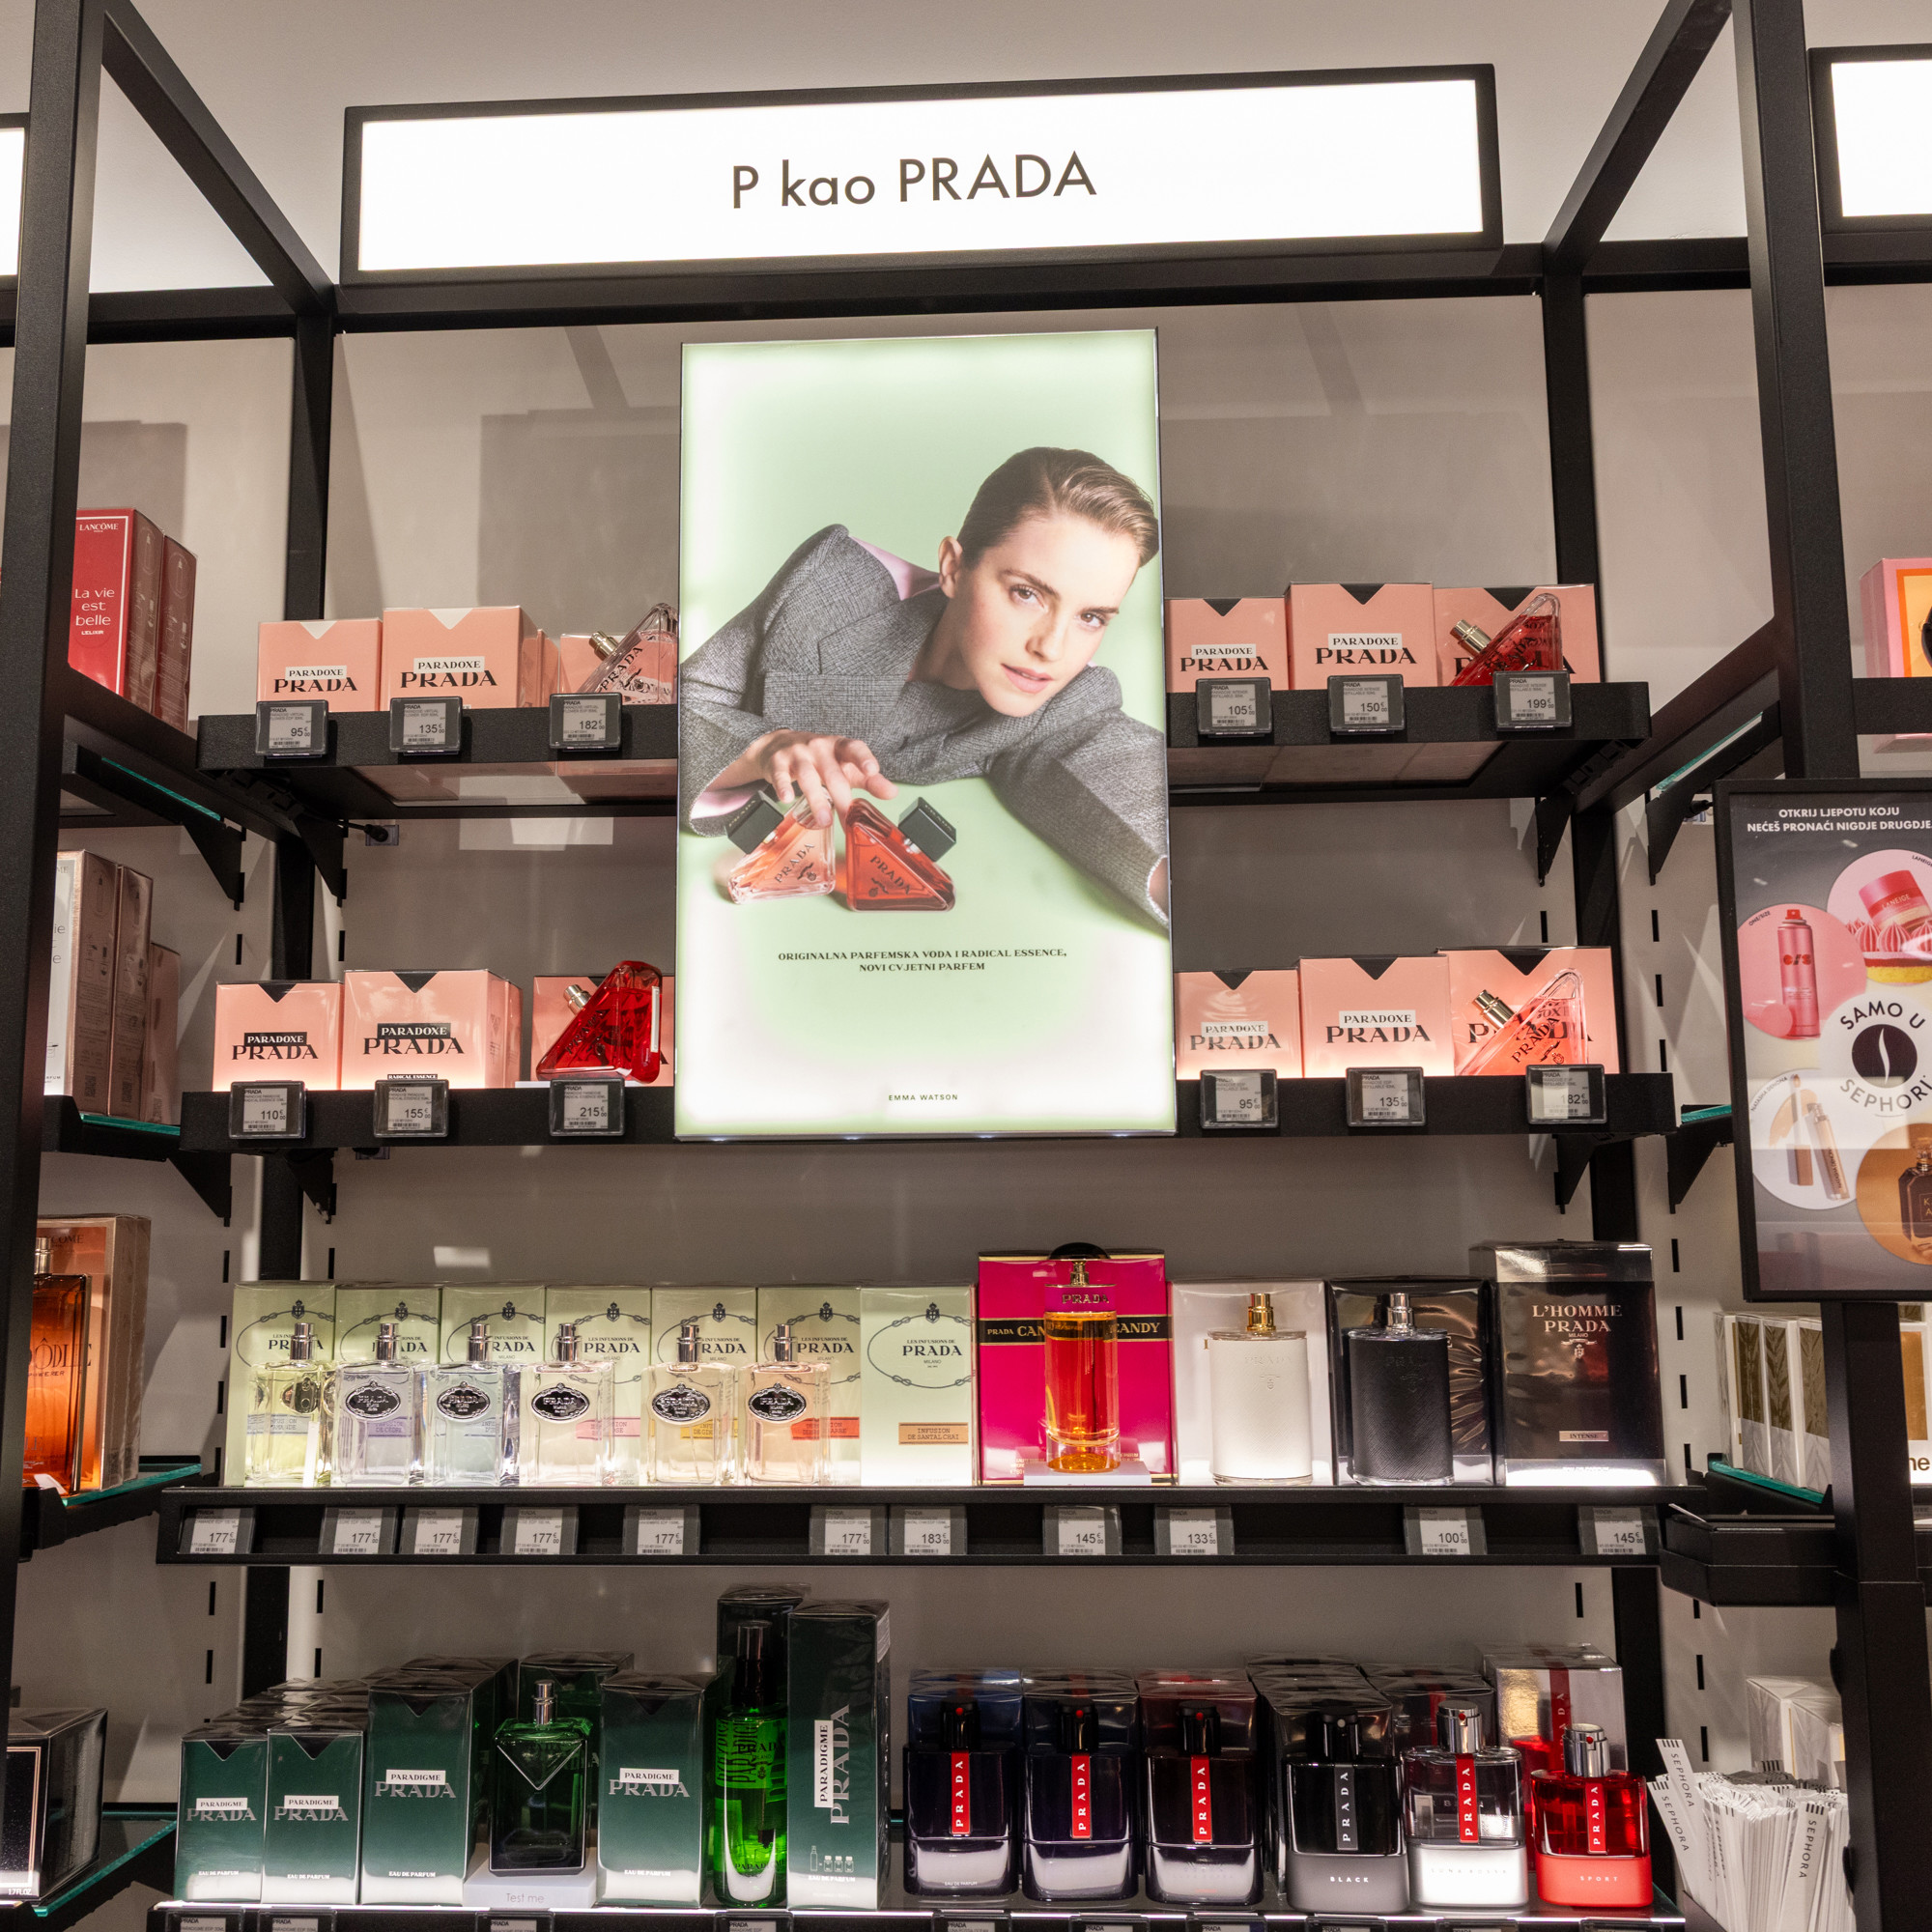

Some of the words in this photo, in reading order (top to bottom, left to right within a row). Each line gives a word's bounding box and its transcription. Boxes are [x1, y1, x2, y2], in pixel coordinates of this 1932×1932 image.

[733, 165, 759, 209] P
[781, 158, 875, 206] kao
[899, 150, 1097, 203] PRADA
[79, 523, 119, 531] LANCÔME
[74, 588, 90, 599] La
[95, 587, 115, 598] vie
[81, 602, 106, 611] est
[75, 614, 111, 626] belle
[1333, 637, 1398, 646] PARADOXE
[1195, 647, 1253, 656] PARADOXE
[1315, 646, 1417, 665] PRADA
[417, 660, 481, 670] PARADOXE
[600, 646, 644, 692] PRADA
[1180, 656, 1269, 672] PRADA
[289, 668, 344, 677] PARADOXE
[400, 669, 497, 689] PRADA
[273, 677, 357, 694] PRADA
[1361, 702, 1380, 712] 150
[1527, 698, 1547, 708] 199
[1229, 705, 1248, 715] 105
[419, 724, 438, 733] 135
[580, 720, 598, 729] 182
[291, 727, 303, 736] 95
[1778, 809, 1817, 818] OTKRIJ
[1820, 808, 1866, 817] LJEPOTU
[1869, 807, 1900, 816] KOJU
[1747, 821, 1780, 832] NEĆEŠ
[1783, 820, 1834, 832] PRONAĆI
[1836, 821, 1878, 831] NIGDJE
[774, 843, 815, 885] PRADA
[869, 855, 912, 895] PRADA
[778, 952, 848, 961] ORIGINALNA
[850, 951, 920, 960] PARFEMSKA
[922, 950, 952, 959] VODA
[954, 950, 959, 958] I
[961, 949, 1012, 958] RADICAL
[1013, 948, 1067, 957] ESSENCE,
[859, 963, 887, 973] NOVI
[888, 962, 936, 972] CVJETNI
[938, 962, 985, 971] PARFEM
[1344, 1014, 1412, 1024] PARADOXE
[1840, 1000, 1903, 1030] SAMO
[1909, 1012, 1926, 1029] U
[381, 1026, 447, 1037] PARADOXE
[1205, 1024, 1265, 1034] PARADOXE
[1325, 1024, 1432, 1043] PRADA
[247, 1035, 304, 1044] PARADOXE
[1190, 1034, 1282, 1051] PRADA
[1511, 1016, 1560, 1063] PRADA
[363, 1037, 465, 1055] PRADA
[232, 1044, 319, 1061] PRADA
[1239, 1098, 1253, 1109] 95
[1379, 1096, 1400, 1107] 135
[1561, 1094, 1580, 1104] 182
[261, 1110, 279, 1120] 110
[405, 1108, 424, 1118] 155
[580, 1106, 600, 1117] 215
[1062, 1293, 1110, 1304] PRADA
[1532, 1304, 1623, 1318] L'HOMME
[1017, 1325, 1045, 1337] CAN
[1545, 1320, 1611, 1332] PRADA
[493, 1341, 536, 1352] RADA
[583, 1342, 640, 1353] PRADA
[702, 1343, 748, 1353] RADA
[797, 1343, 855, 1353] PRADA
[902, 1346, 962, 1356] PRADA
[209, 1532, 228, 1543] 177
[352, 1533, 371, 1544] 177
[433, 1533, 453, 1544] 177
[532, 1533, 553, 1544] 177
[655, 1533, 675, 1544] 177
[841, 1533, 862, 1544] 177
[922, 1533, 942, 1544] 183
[1075, 1533, 1096, 1544] 145
[1187, 1533, 1208, 1544] 133
[1438, 1532, 1460, 1544] 100
[1613, 1532, 1635, 1544] 145
[819, 1724, 828, 1803] PARADIGME
[830, 1704, 851, 1825] PRADA
[624, 1772, 674, 1780] PARADIGME
[1670, 1753, 1695, 1807] SEPHORA
[374, 1781, 456, 1799] PRADA
[609, 1778, 691, 1798] PRADA
[955, 1760, 964, 1828] PRADA
[1077, 1763, 1087, 1831] PRADA
[1197, 1767, 1208, 1835] PRADA
[1462, 1767, 1474, 1837] PRADA
[1340, 1772, 1350, 1842] PRADA
[186, 1807, 257, 1822] PRADA
[273, 1806, 349, 1822] PRADA
[1590, 1786, 1601, 1846] PRADA
[1662, 1796, 1690, 1851] SEPHORA
[1799, 1820, 1817, 1878] SEPHORA
[506, 1892, 526, 1902] Test
